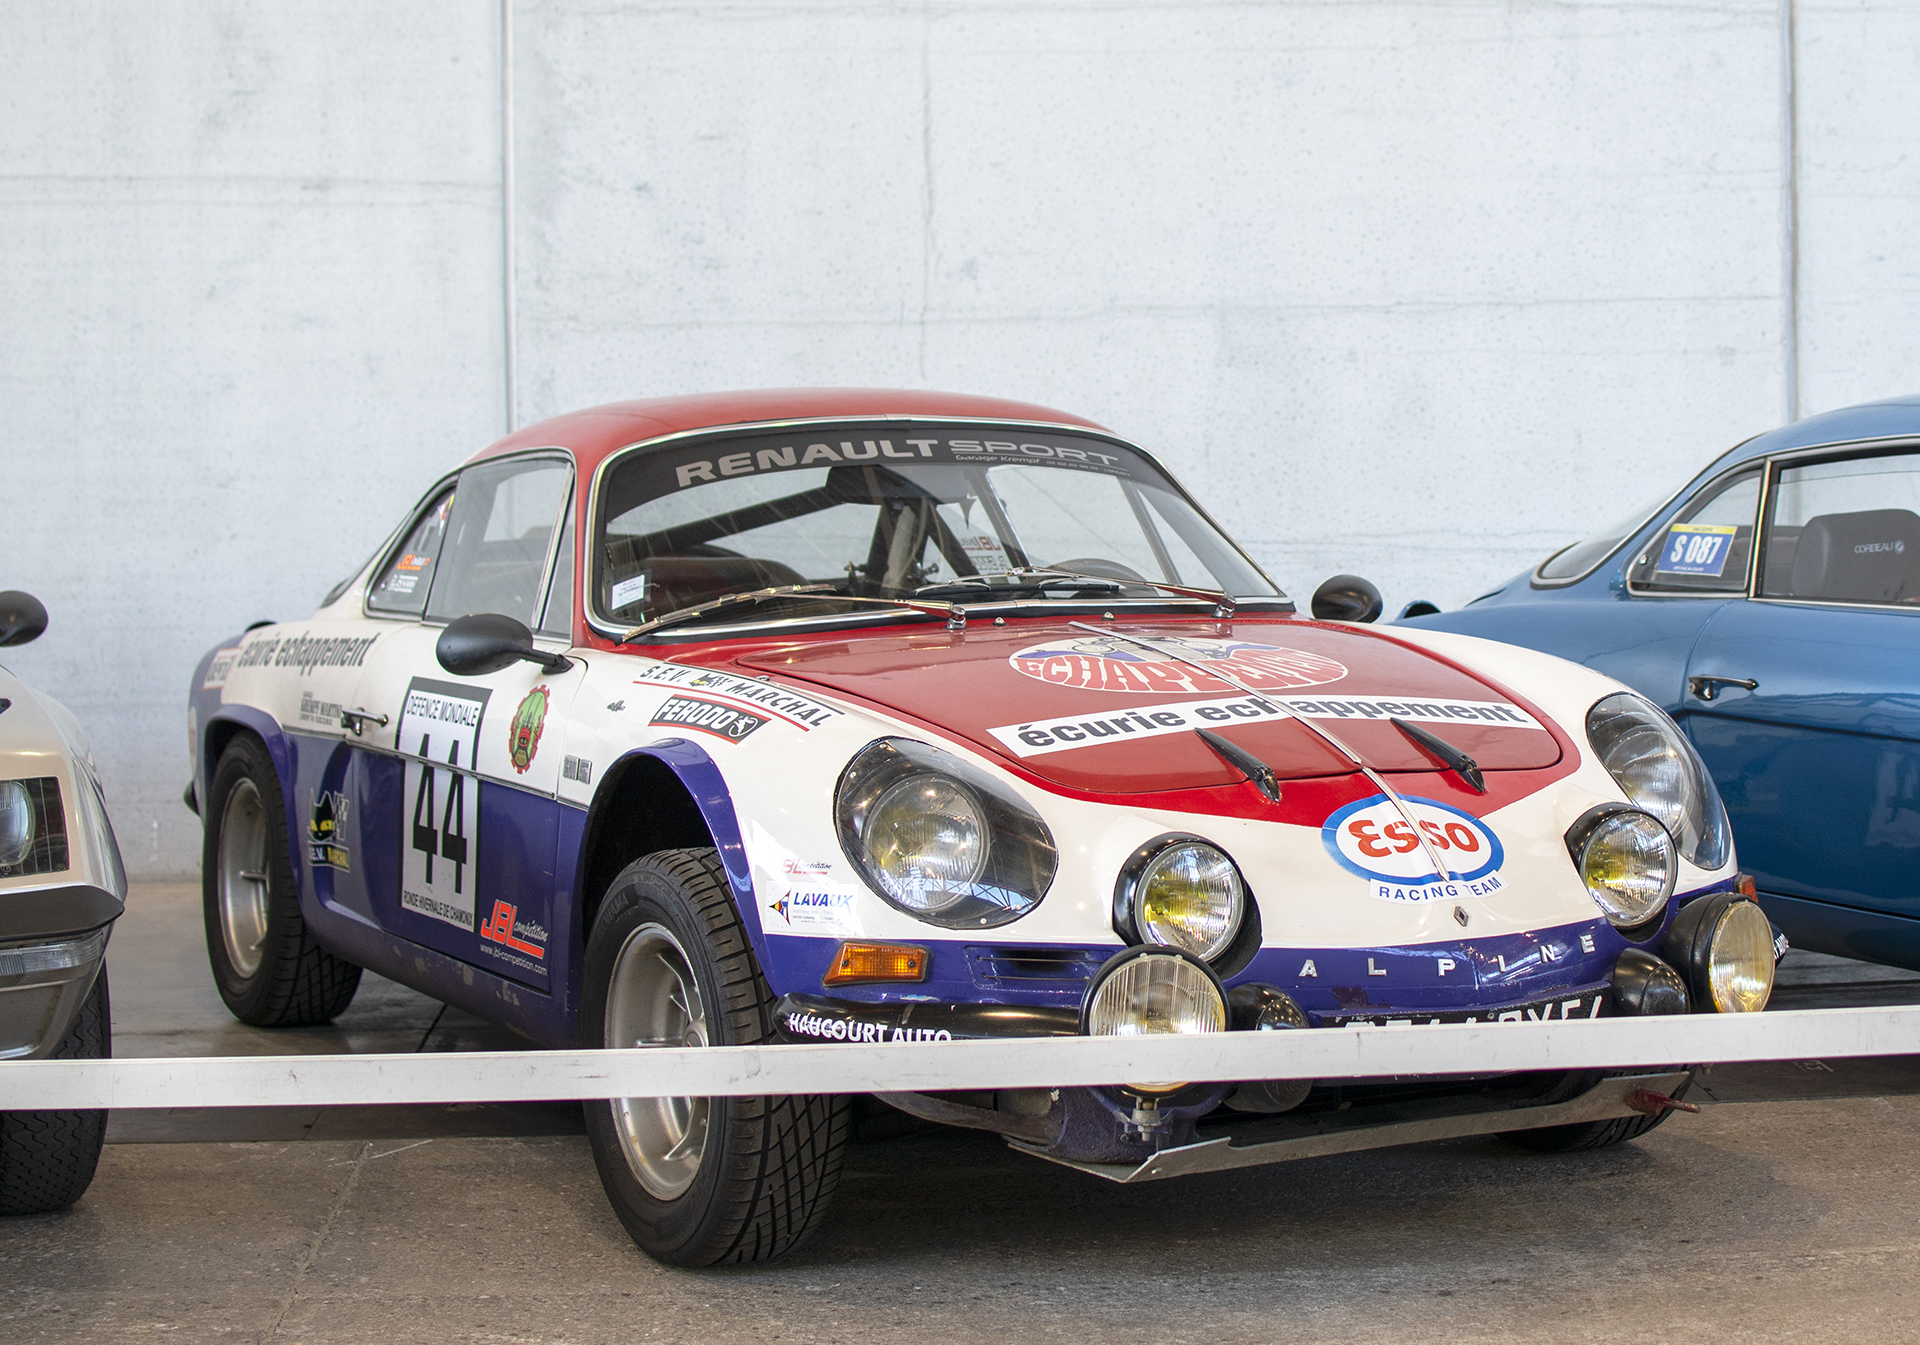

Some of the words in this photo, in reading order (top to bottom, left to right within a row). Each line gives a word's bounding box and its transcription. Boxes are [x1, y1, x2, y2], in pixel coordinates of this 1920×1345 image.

[675, 439, 939, 488] RENAULT
[948, 440, 1119, 466] SPORT
[955, 454, 998, 462] Garage
[1000, 455, 1041, 464] Krempf
[1670, 534, 1688, 563] S
[1684, 535, 1724, 565] 087
[1854, 542, 1894, 554] CORBEAU
[274, 630, 382, 676] echappement
[406, 695, 441, 720] DEFENCE
[438, 701, 479, 728] MONDIALE
[639, 665, 691, 682] S.E.V.
[725, 683, 832, 727] MARCHAL
[654, 698, 740, 730] FERODO
[1018, 711, 1187, 747] écurie
[412, 733, 468, 895] 44
[793, 892, 854, 916] LAVAUX
[1378, 884, 1459, 901] RACING
[1463, 877, 1503, 897] TEAM
[513, 920, 549, 943] compétition
[788, 1012, 888, 1043] HAUCOURT
[891, 1027, 952, 1043] AUTO
